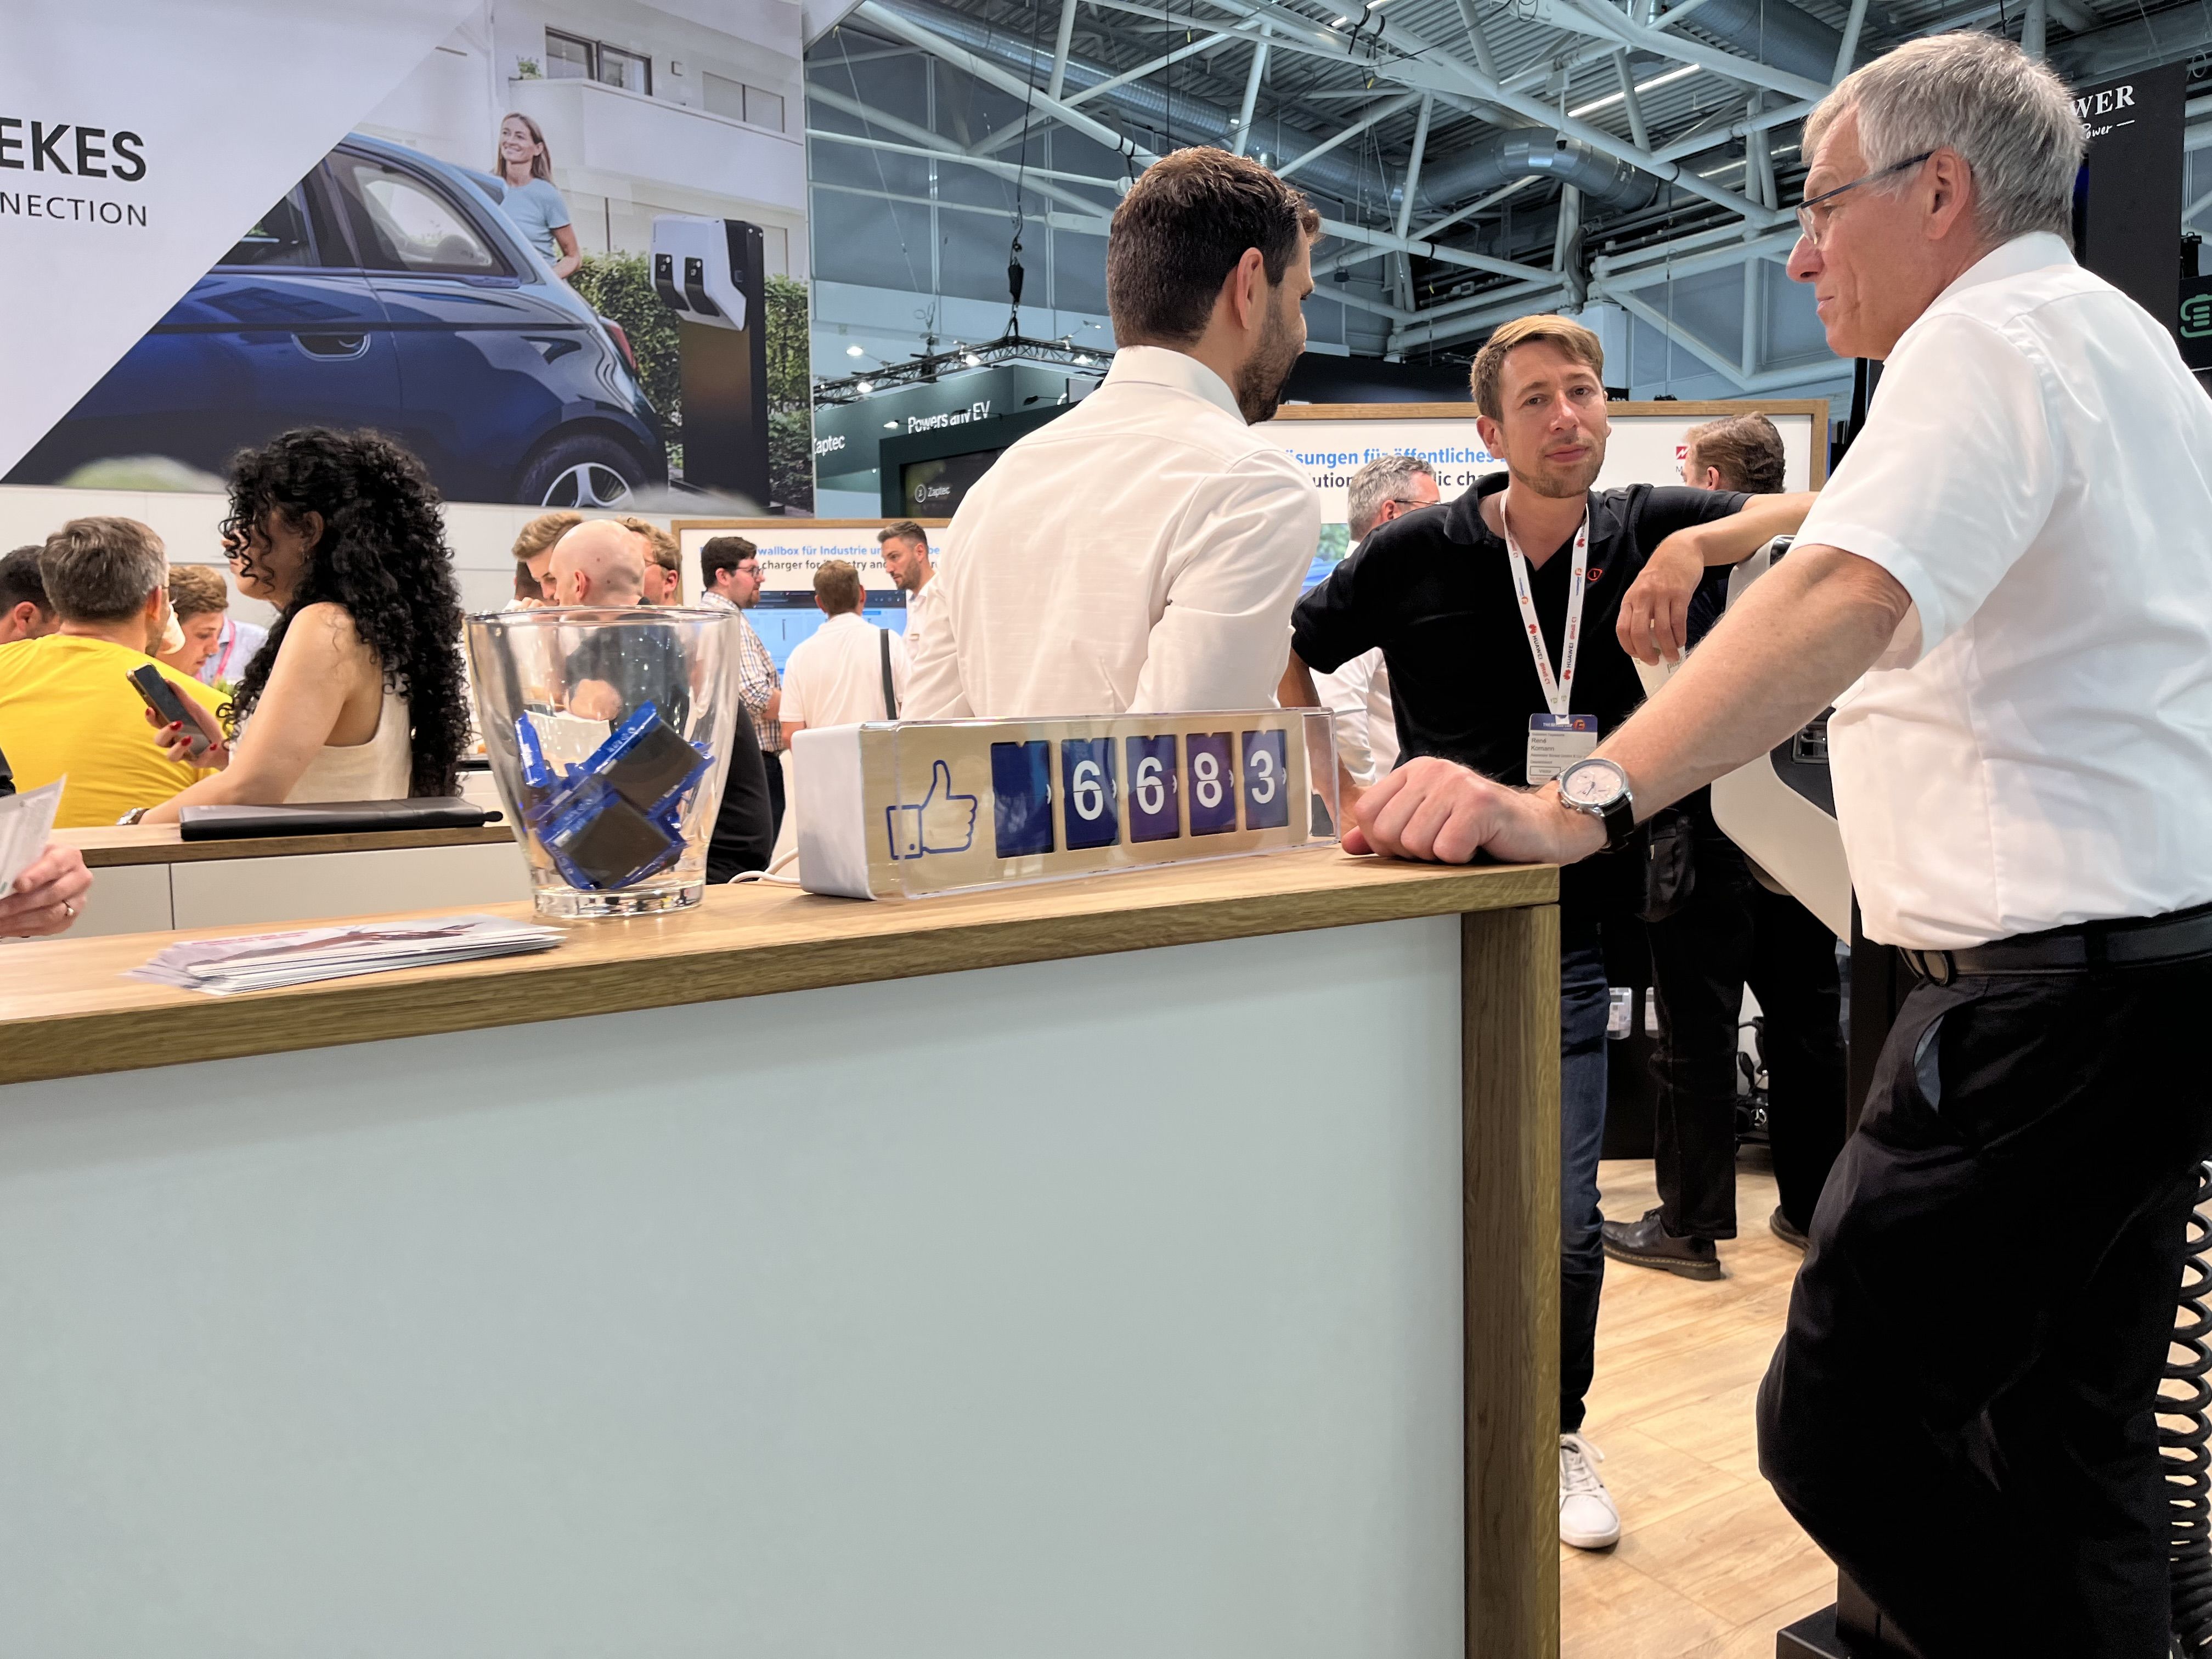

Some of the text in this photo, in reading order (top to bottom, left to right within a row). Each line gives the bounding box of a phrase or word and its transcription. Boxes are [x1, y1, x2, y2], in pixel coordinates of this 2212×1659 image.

[0, 191, 146, 227] NECTION
[908, 413, 949, 434] Powers
[973, 400, 991, 421] EV
[803, 546, 817, 555] für
[820, 545, 867, 555] Industrie
[762, 560, 802, 571] charger
[806, 560, 820, 569] for
[1532, 635, 1543, 659] HUAWEI
